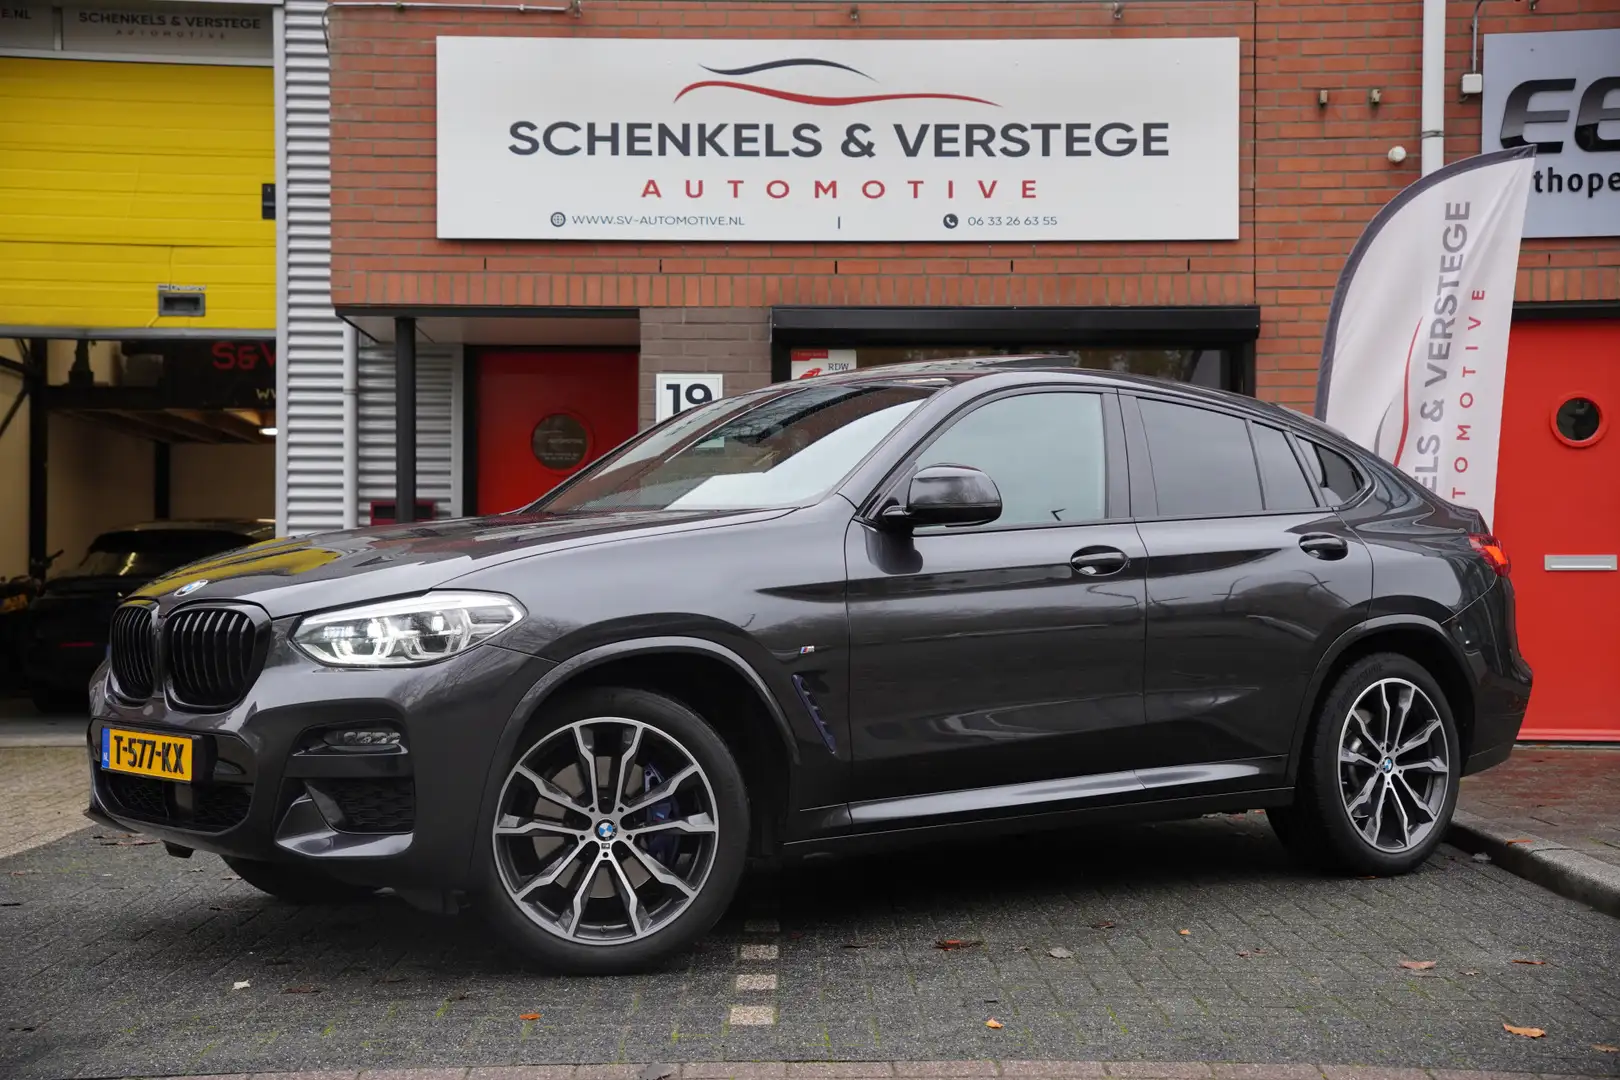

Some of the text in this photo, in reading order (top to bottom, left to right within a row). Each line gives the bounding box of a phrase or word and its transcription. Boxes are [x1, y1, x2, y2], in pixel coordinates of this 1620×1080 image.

[79, 12, 261, 29] SCHENKELS & VERSTEGE
[116, 29, 226, 40] AUTOMOTIVE
[508, 121, 1169, 157] SCHENKELS & VERSTEGE
[641, 179, 1037, 199] AUTOMOTIVE
[571, 215, 745, 226] WWW.SV-AUTOMOTIVE.NL
[967, 216, 1058, 226] 06 33 26 63 55
[1424, 201, 1471, 388] VERSTEGE
[828, 363, 849, 371] RDW
[666, 383, 713, 415] 19
[1420, 398, 1444, 422] &
[114, 735, 185, 774] T-577-KX
